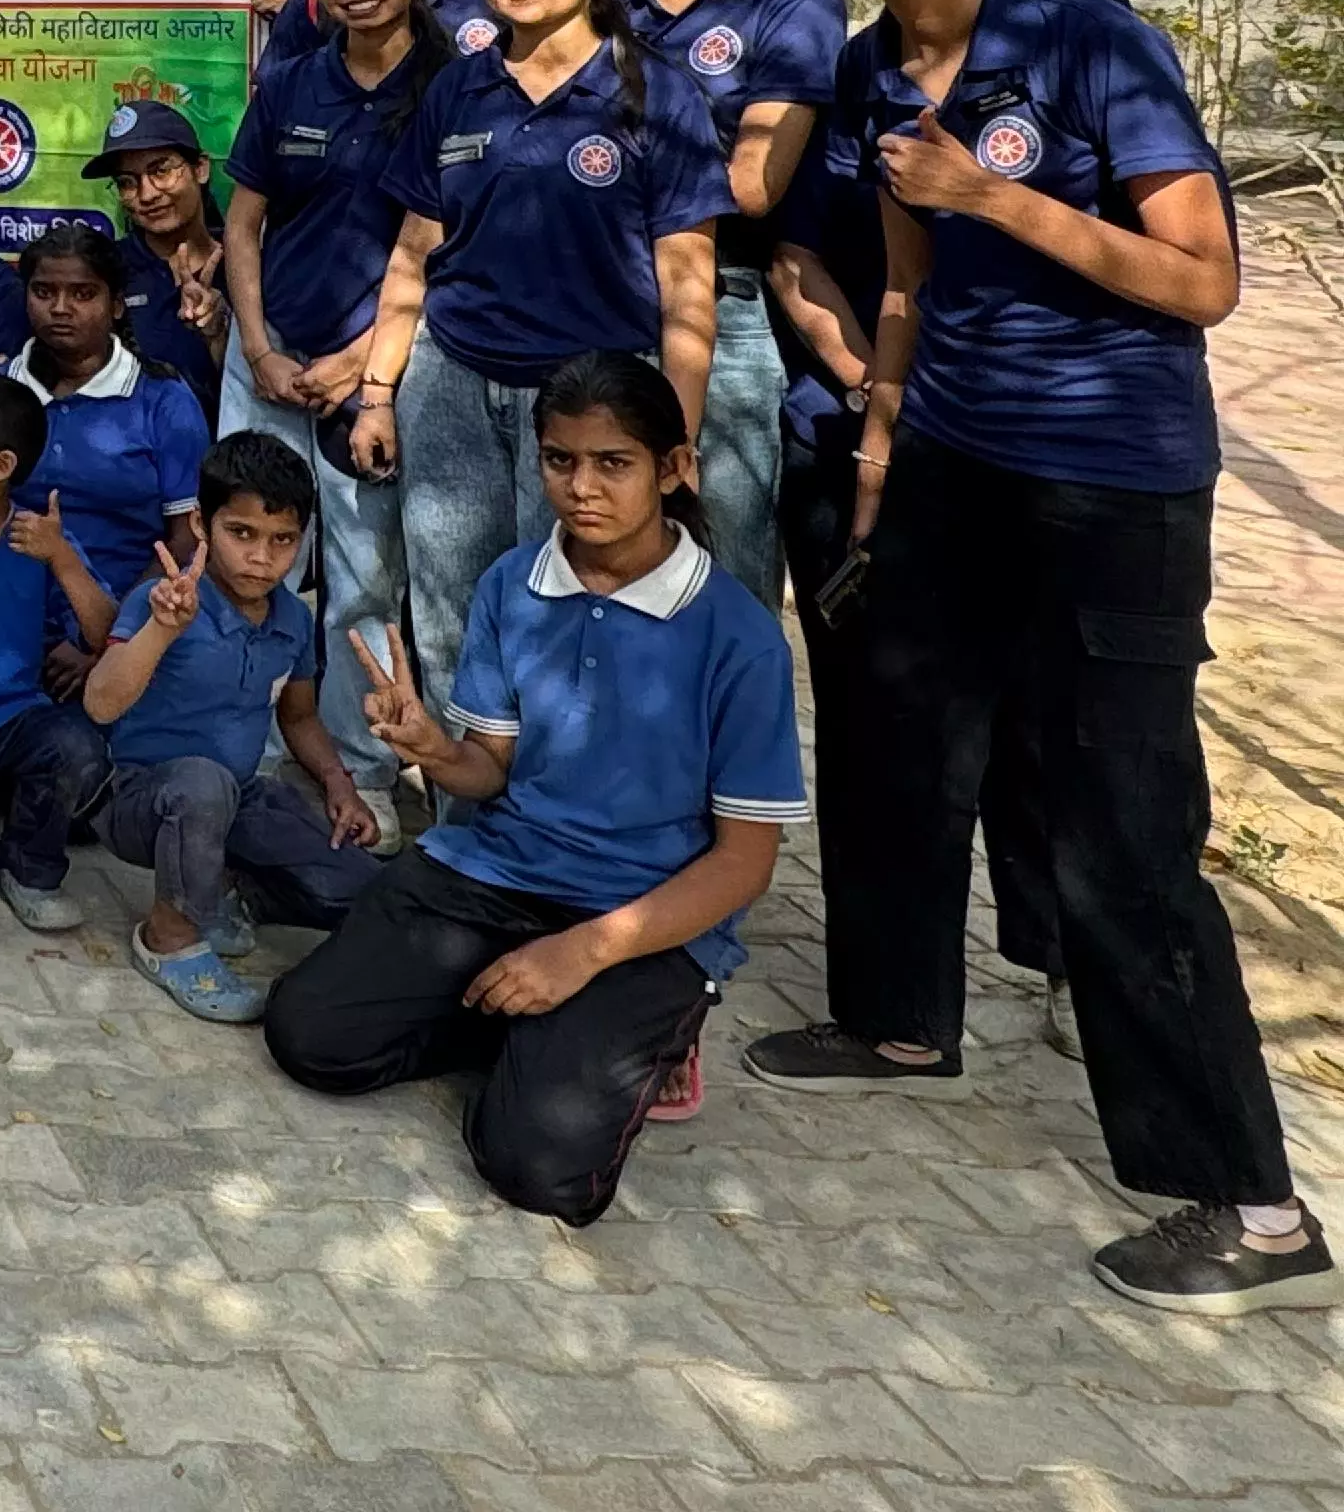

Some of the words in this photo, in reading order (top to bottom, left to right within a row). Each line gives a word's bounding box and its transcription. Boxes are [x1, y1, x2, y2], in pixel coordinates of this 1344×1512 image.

[41, 11, 161, 44] महाविद्यालय
[166, 11, 236, 41] अजमेर
[23, 49, 98, 83] योजना
